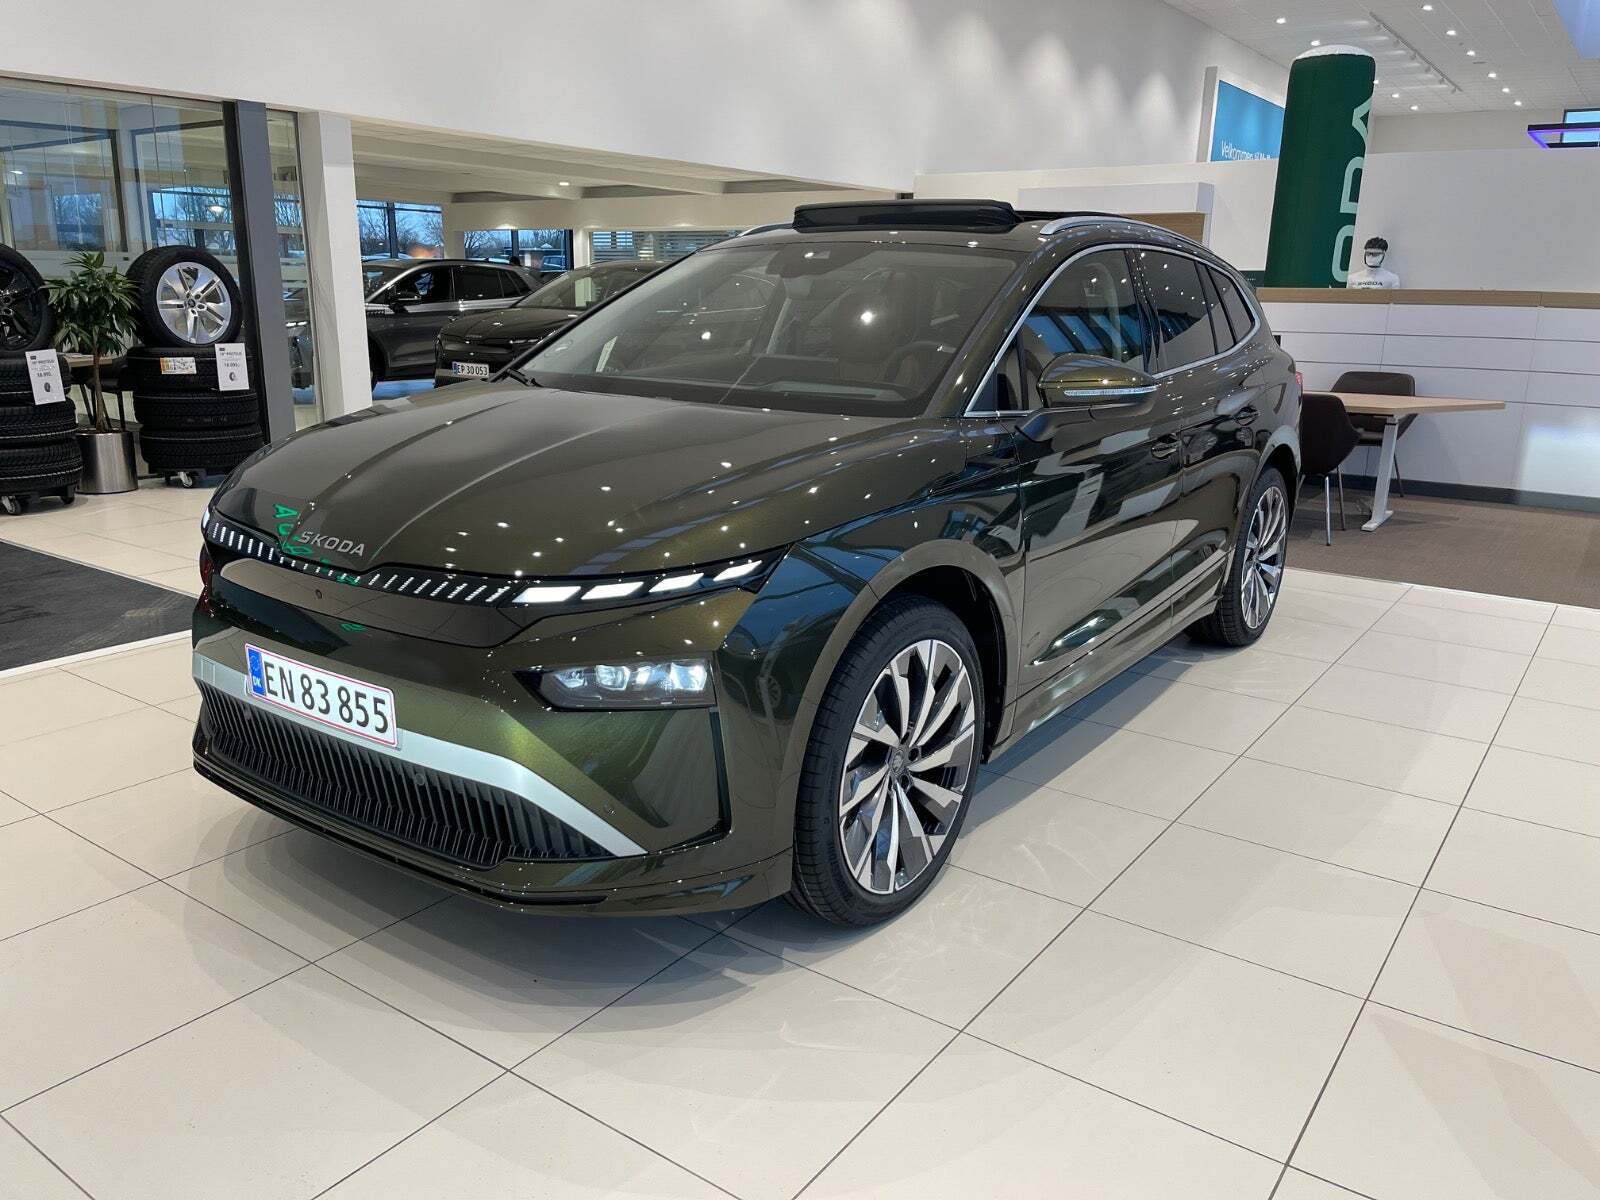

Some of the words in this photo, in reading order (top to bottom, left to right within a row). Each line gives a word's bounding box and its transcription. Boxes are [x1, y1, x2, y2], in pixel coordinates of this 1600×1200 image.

[264, 661, 296, 703] EN
[300, 673, 331, 715] 83
[337, 686, 389, 734] 855
